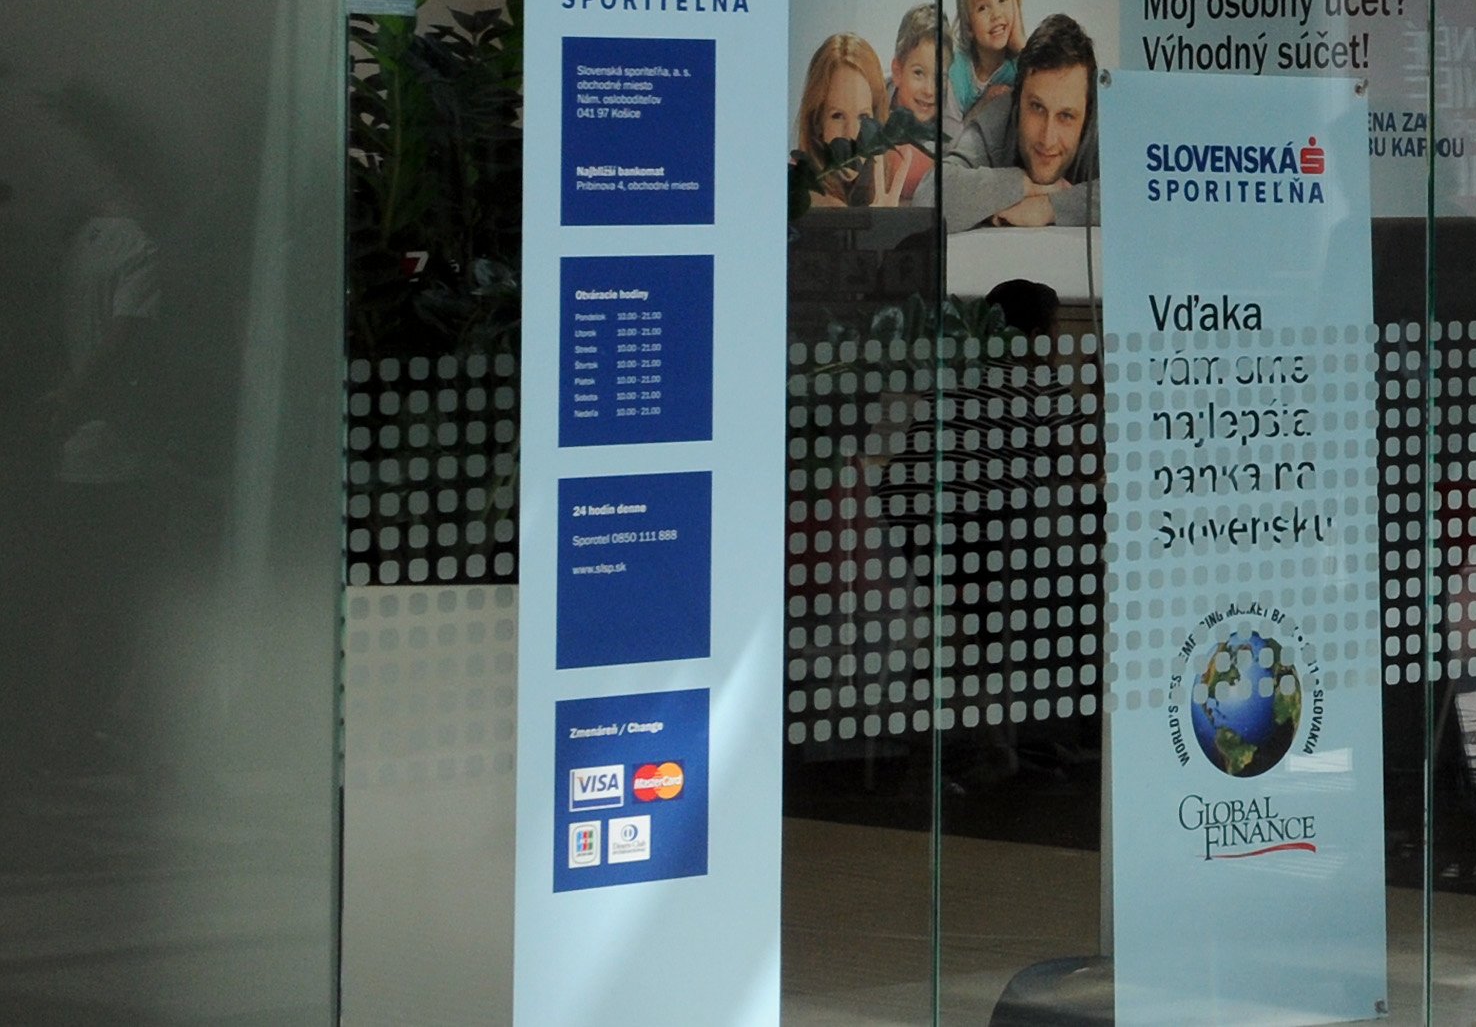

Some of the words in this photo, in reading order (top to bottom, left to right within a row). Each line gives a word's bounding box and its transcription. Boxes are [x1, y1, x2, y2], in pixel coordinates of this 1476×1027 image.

[1142, 32, 1268, 75] Výhodný
[1277, 31, 1369, 70] súčet!
[577, 65, 622, 76] Slovenská
[577, 80, 621, 90] obchodné
[623, 81, 653, 90] miesto
[577, 108, 595, 118] 041
[597, 108, 609, 118] 97
[612, 108, 641, 118] Košice
[1146, 141, 1299, 174] SLOVENSKÁ
[618, 167, 664, 176] bankomat
[628, 180, 669, 190] obchodné
[671, 181, 699, 190] miesto
[1147, 178, 1325, 205] SPORITEĽŇA
[575, 289, 617, 300] Otváracie
[619, 289, 649, 301] hodiny
[1149, 293, 1262, 332] Vďaka
[572, 505, 586, 517] 24
[617, 504, 647, 514] denne
[1153, 506, 1333, 549] Sovensku
[612, 532, 637, 544] 0850
[639, 531, 656, 542] 111
[658, 529, 677, 541] 888
[572, 562, 627, 574] www.slsp.sk
[627, 722, 664, 734] Change
[1302, 689, 1324, 755] SLOVAKIA
[577, 773, 619, 793] VISA
[633, 774, 684, 790] MasterCard
[1205, 816, 1316, 861] FINANCE
